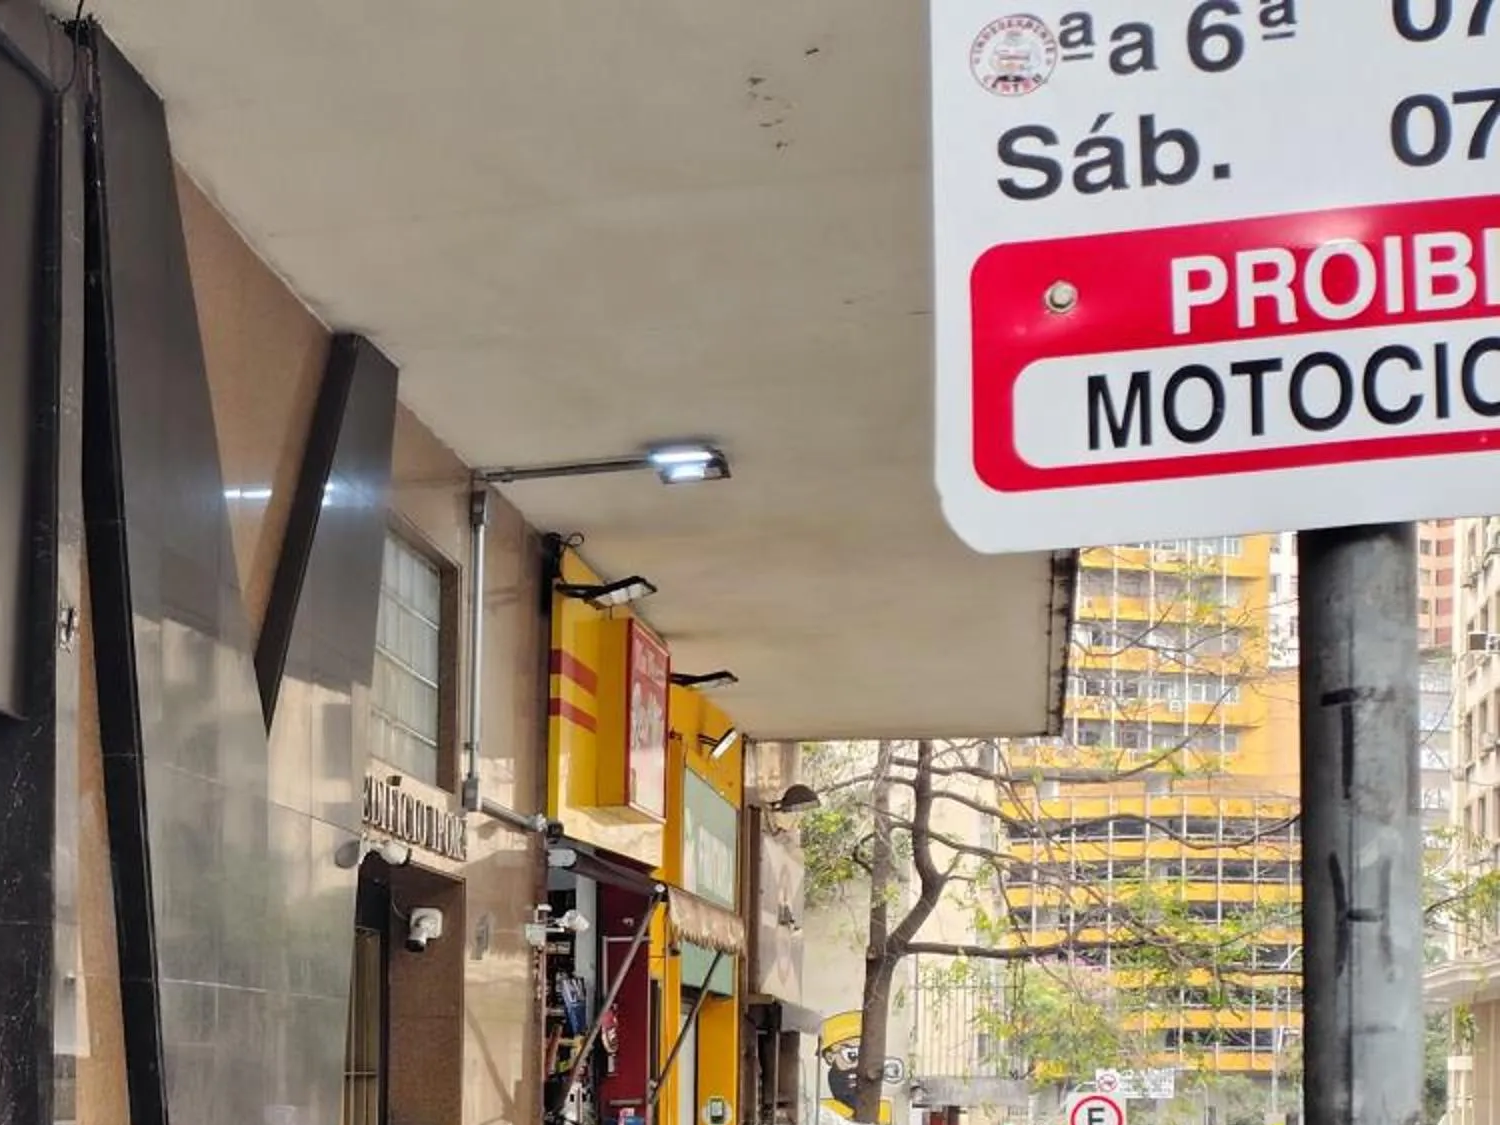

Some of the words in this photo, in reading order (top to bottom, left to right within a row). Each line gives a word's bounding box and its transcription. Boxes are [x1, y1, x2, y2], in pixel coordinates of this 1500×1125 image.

[1108, 22, 1157, 75] a
[997, 112, 1231, 200] Sáb.
[1390, 87, 1500, 167] 07
